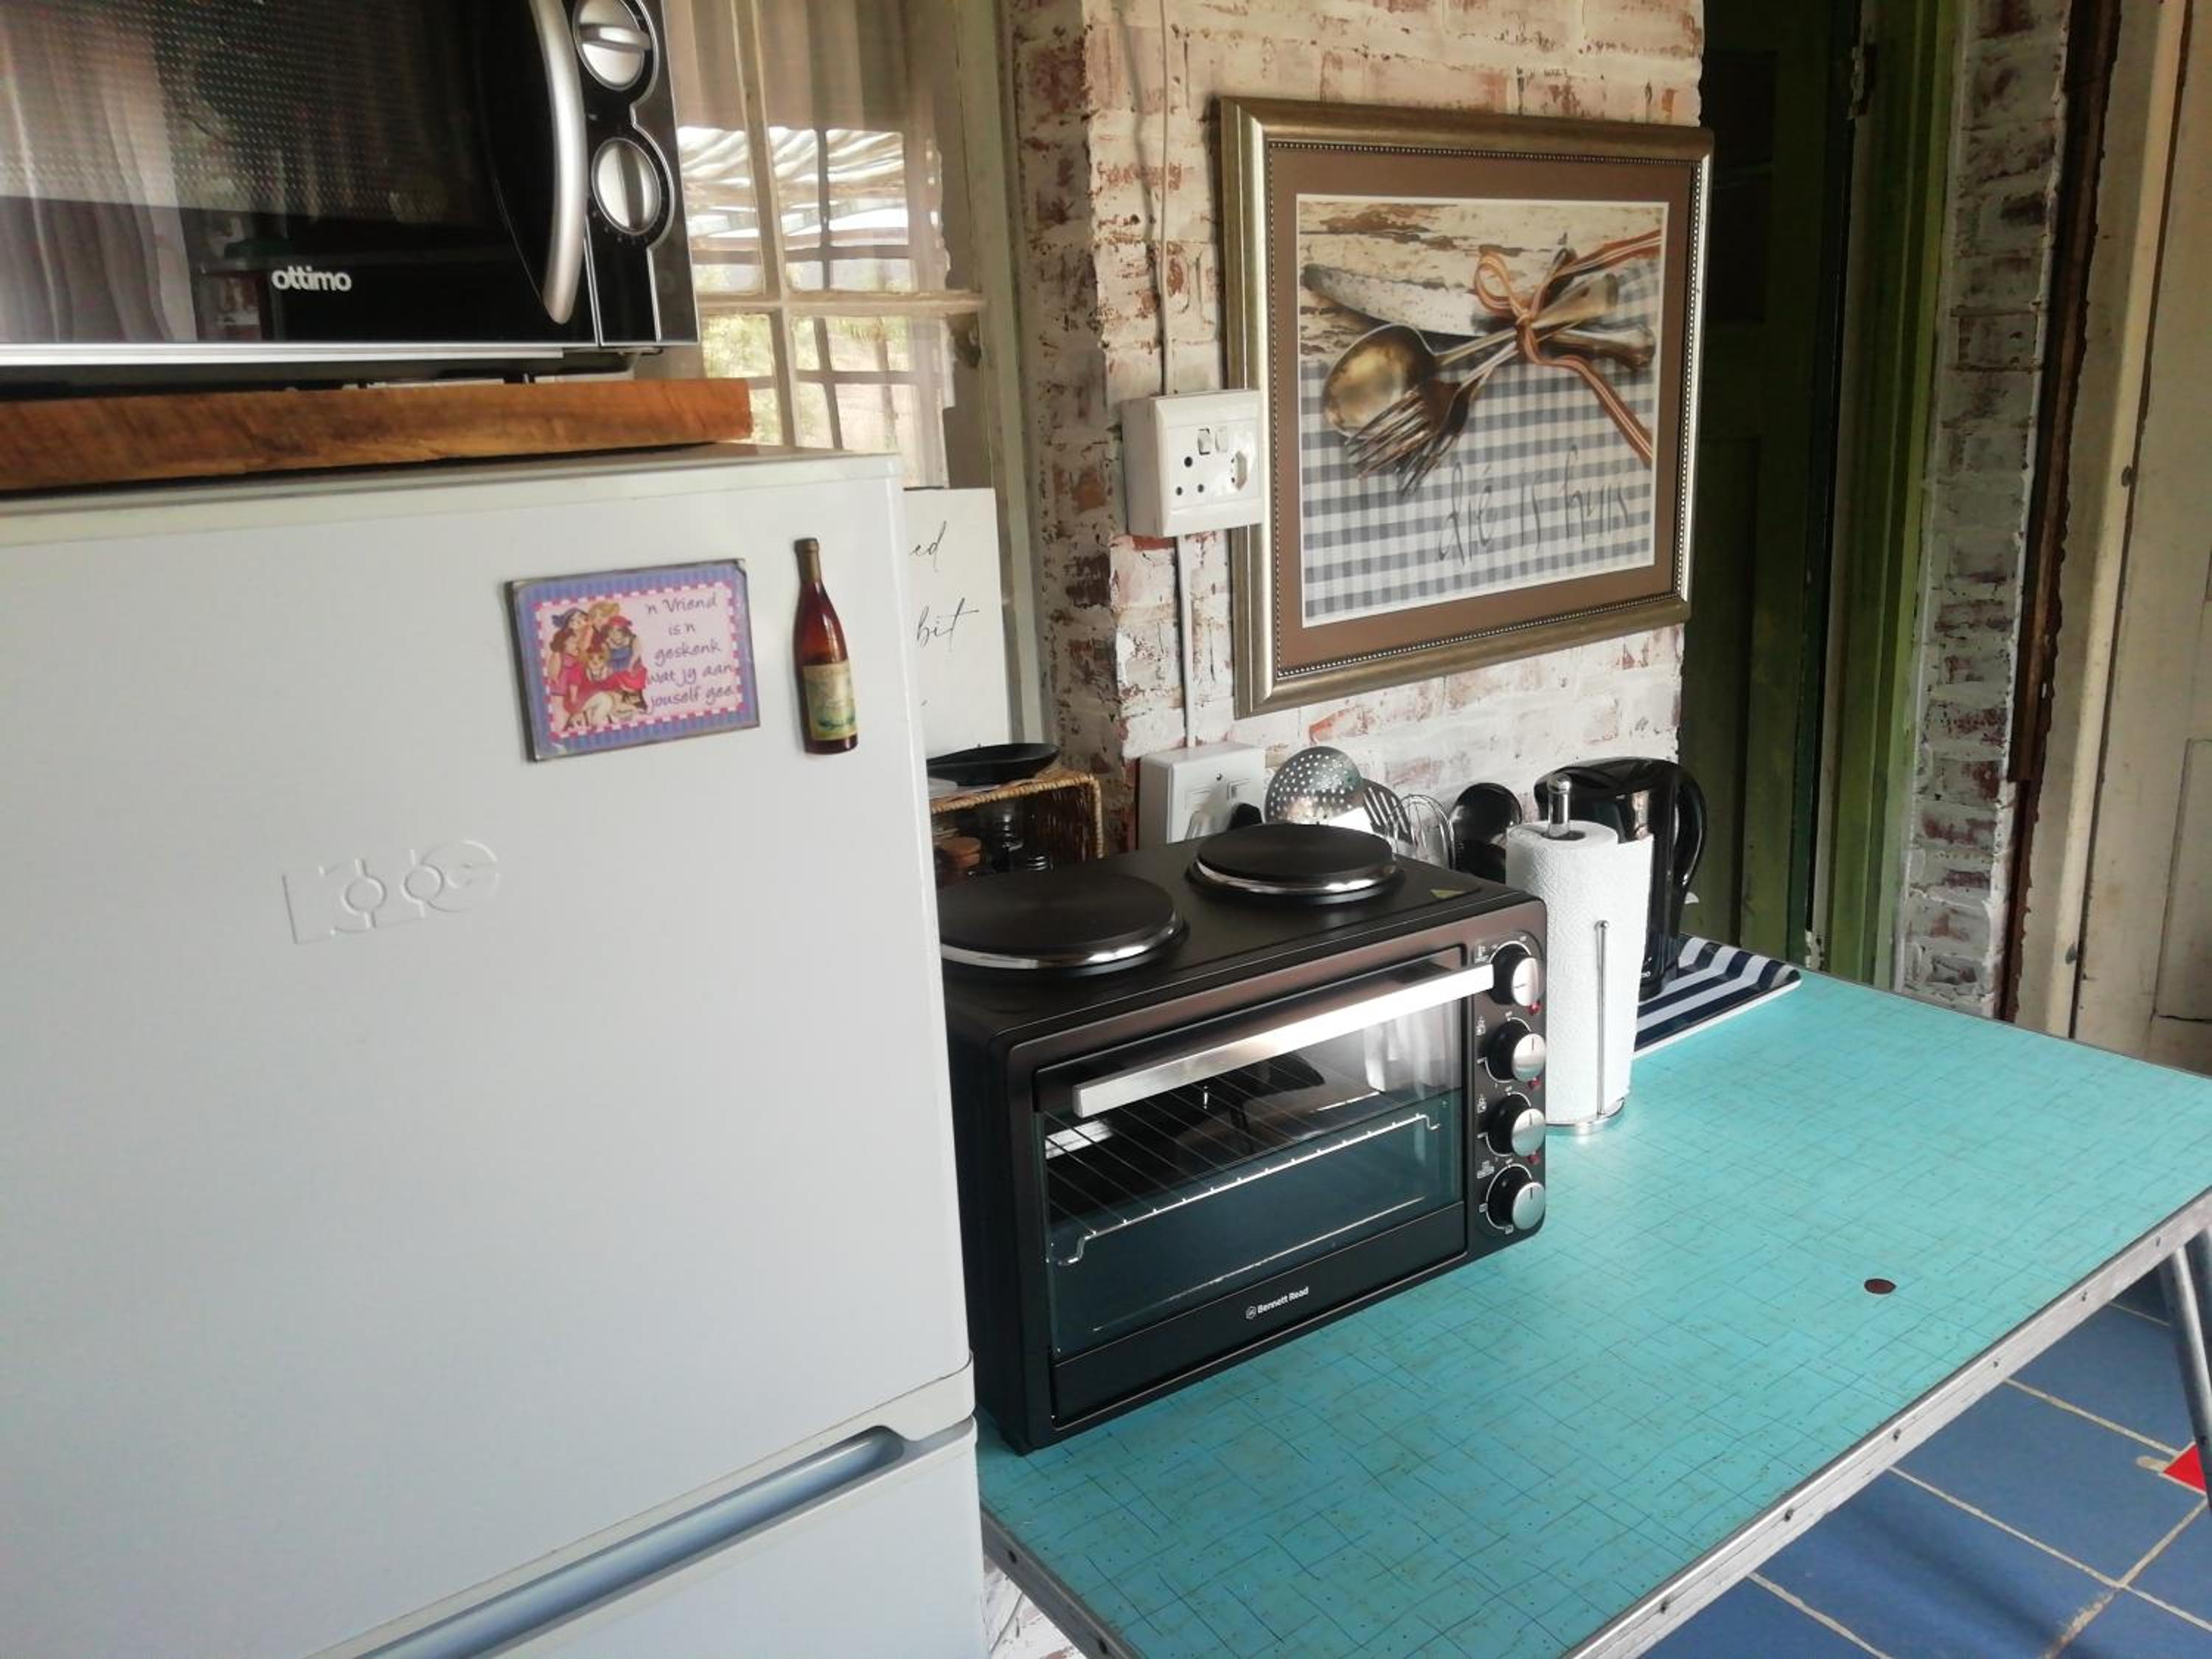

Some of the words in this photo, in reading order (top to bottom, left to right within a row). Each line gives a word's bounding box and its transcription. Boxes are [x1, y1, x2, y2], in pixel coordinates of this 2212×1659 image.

[271, 265, 352, 291] ottimo
[661, 591, 717, 613] Vriend
[667, 625, 682, 636] is
[917, 597, 979, 652] bit
[654, 638, 720, 667] geskenk
[648, 669, 675, 684] wat
[702, 664, 732, 677] aan
[648, 686, 701, 714] jouself
[1258, 1295, 1288, 1314] Bennett
[1289, 1286, 1309, 1301] Read
